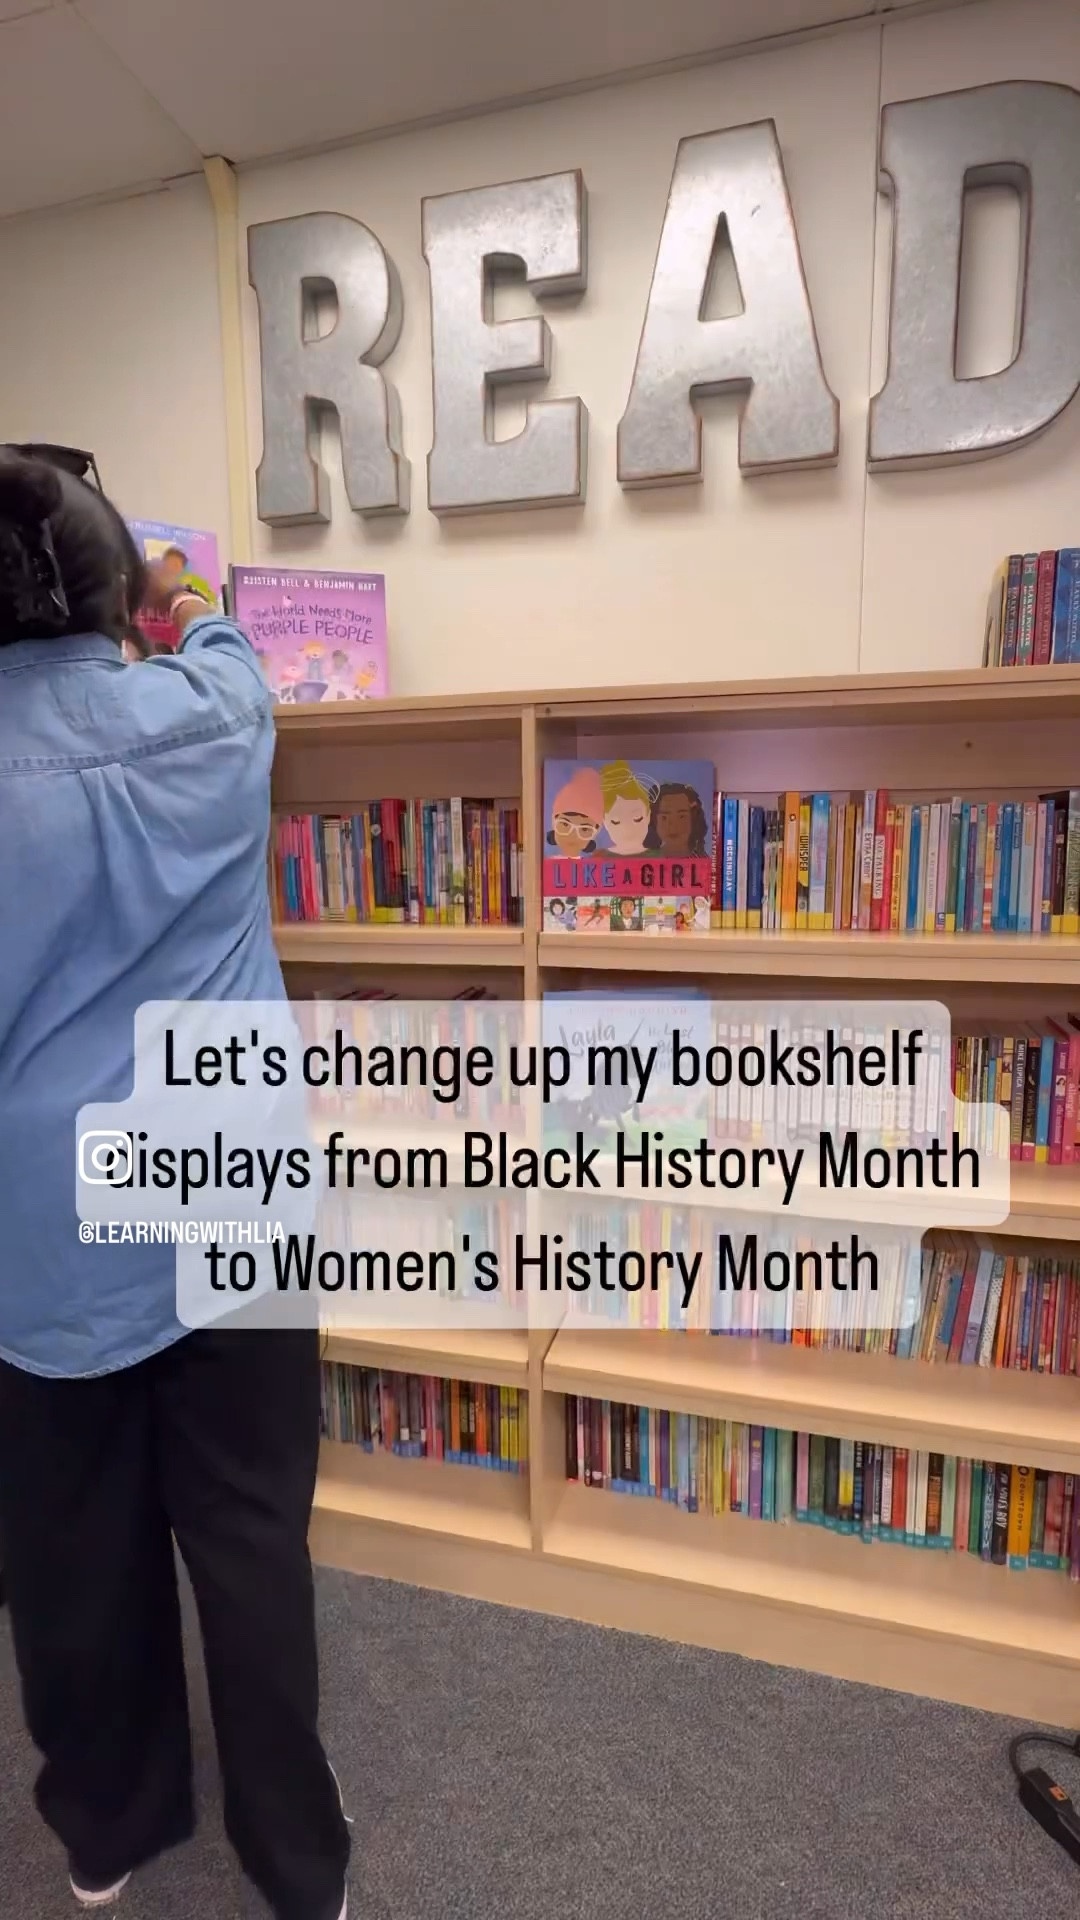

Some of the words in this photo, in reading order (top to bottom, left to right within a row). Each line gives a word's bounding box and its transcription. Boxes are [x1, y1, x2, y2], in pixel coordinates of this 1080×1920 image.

[247, 79, 1080, 527] READ
[281, 578, 300, 588] BELL
[314, 580, 355, 590] BENJAMIN
[1026, 584, 1034, 616] HARRY
[308, 604, 342, 620] Needs
[345, 608, 373, 625] More
[251, 619, 310, 641] PURPLE
[315, 619, 374, 645] PEOPLE
[799, 835, 809, 872] WHISPER
[863, 832, 873, 855] EXTRA
[553, 863, 616, 888] LIKE
[622, 868, 633, 885] A
[640, 863, 703, 888] GIRL
[1017, 1044, 1025, 1064] MIKE
[1016, 1065, 1024, 1088] LUPICA
[1016, 1477, 1026, 1532] COUNTDOWN
